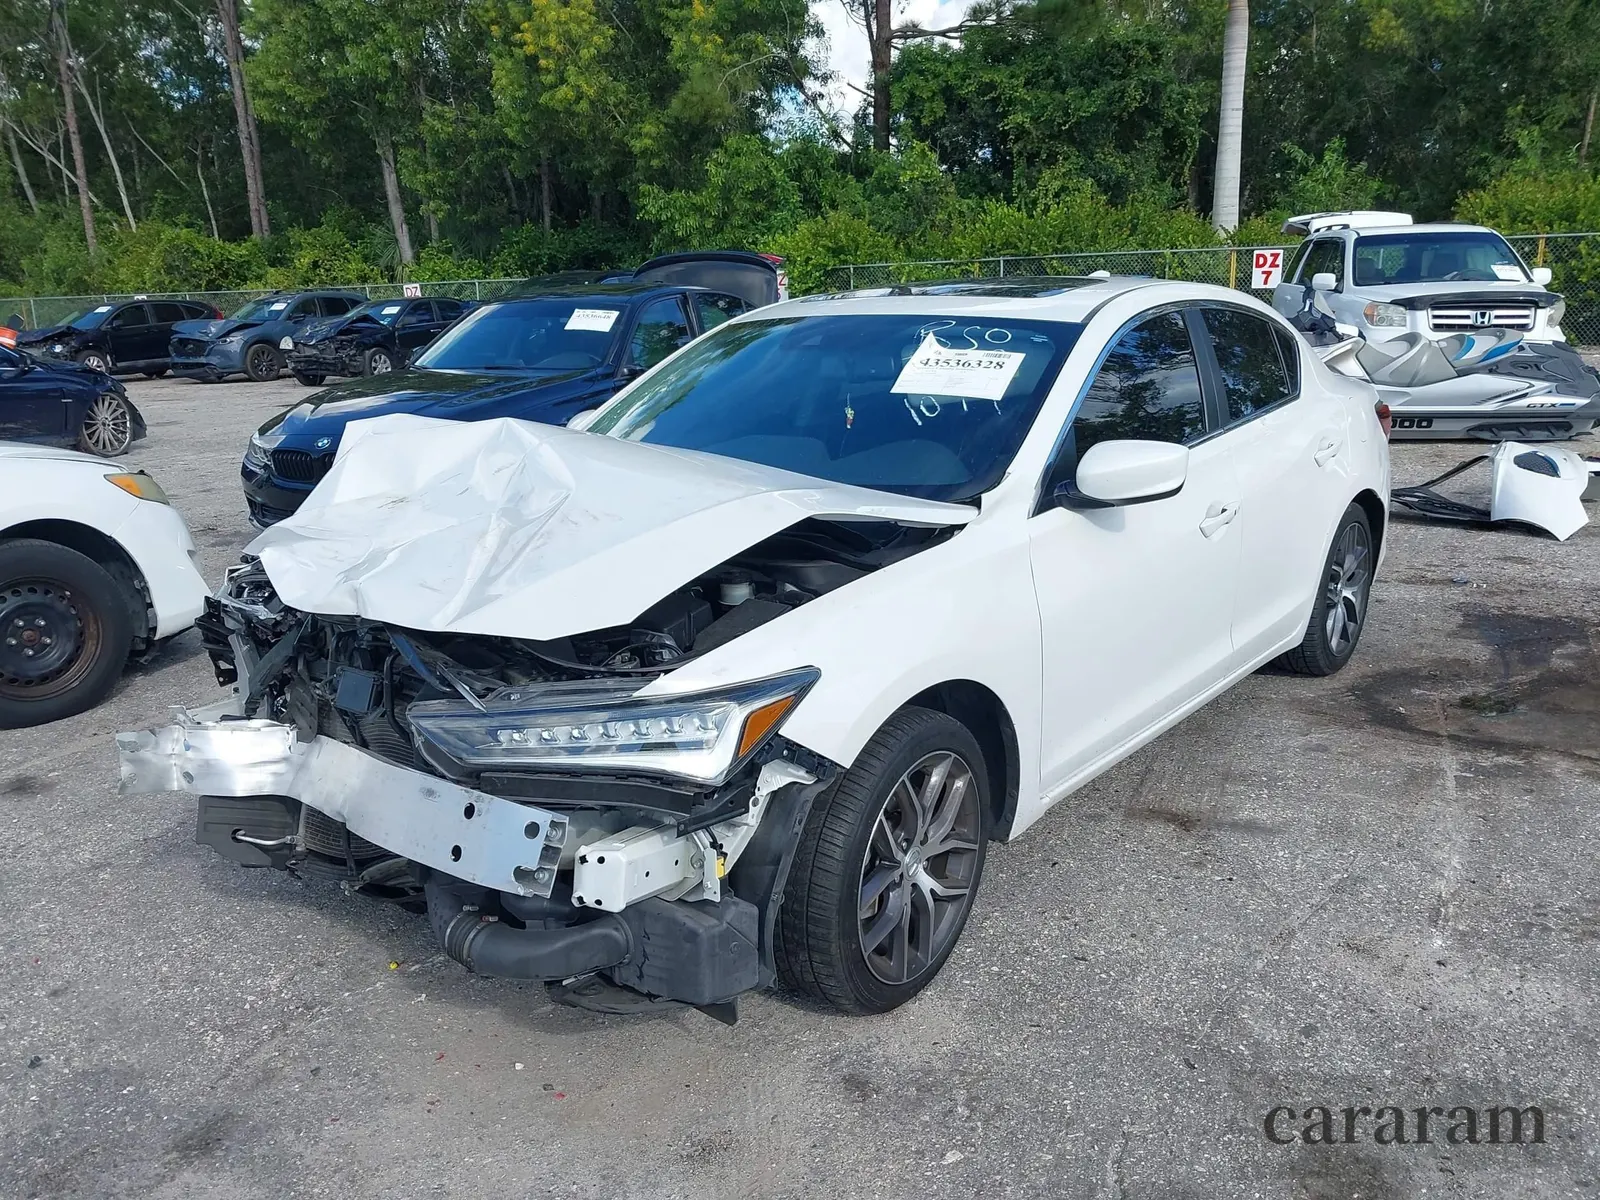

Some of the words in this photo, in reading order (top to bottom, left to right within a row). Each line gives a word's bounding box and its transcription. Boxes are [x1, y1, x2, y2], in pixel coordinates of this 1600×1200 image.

[1255, 253, 1281, 268] DZ
[1261, 271, 1272, 285] 7
[405, 286, 419, 297] DZ
[919, 358, 1006, 370] 43536328
